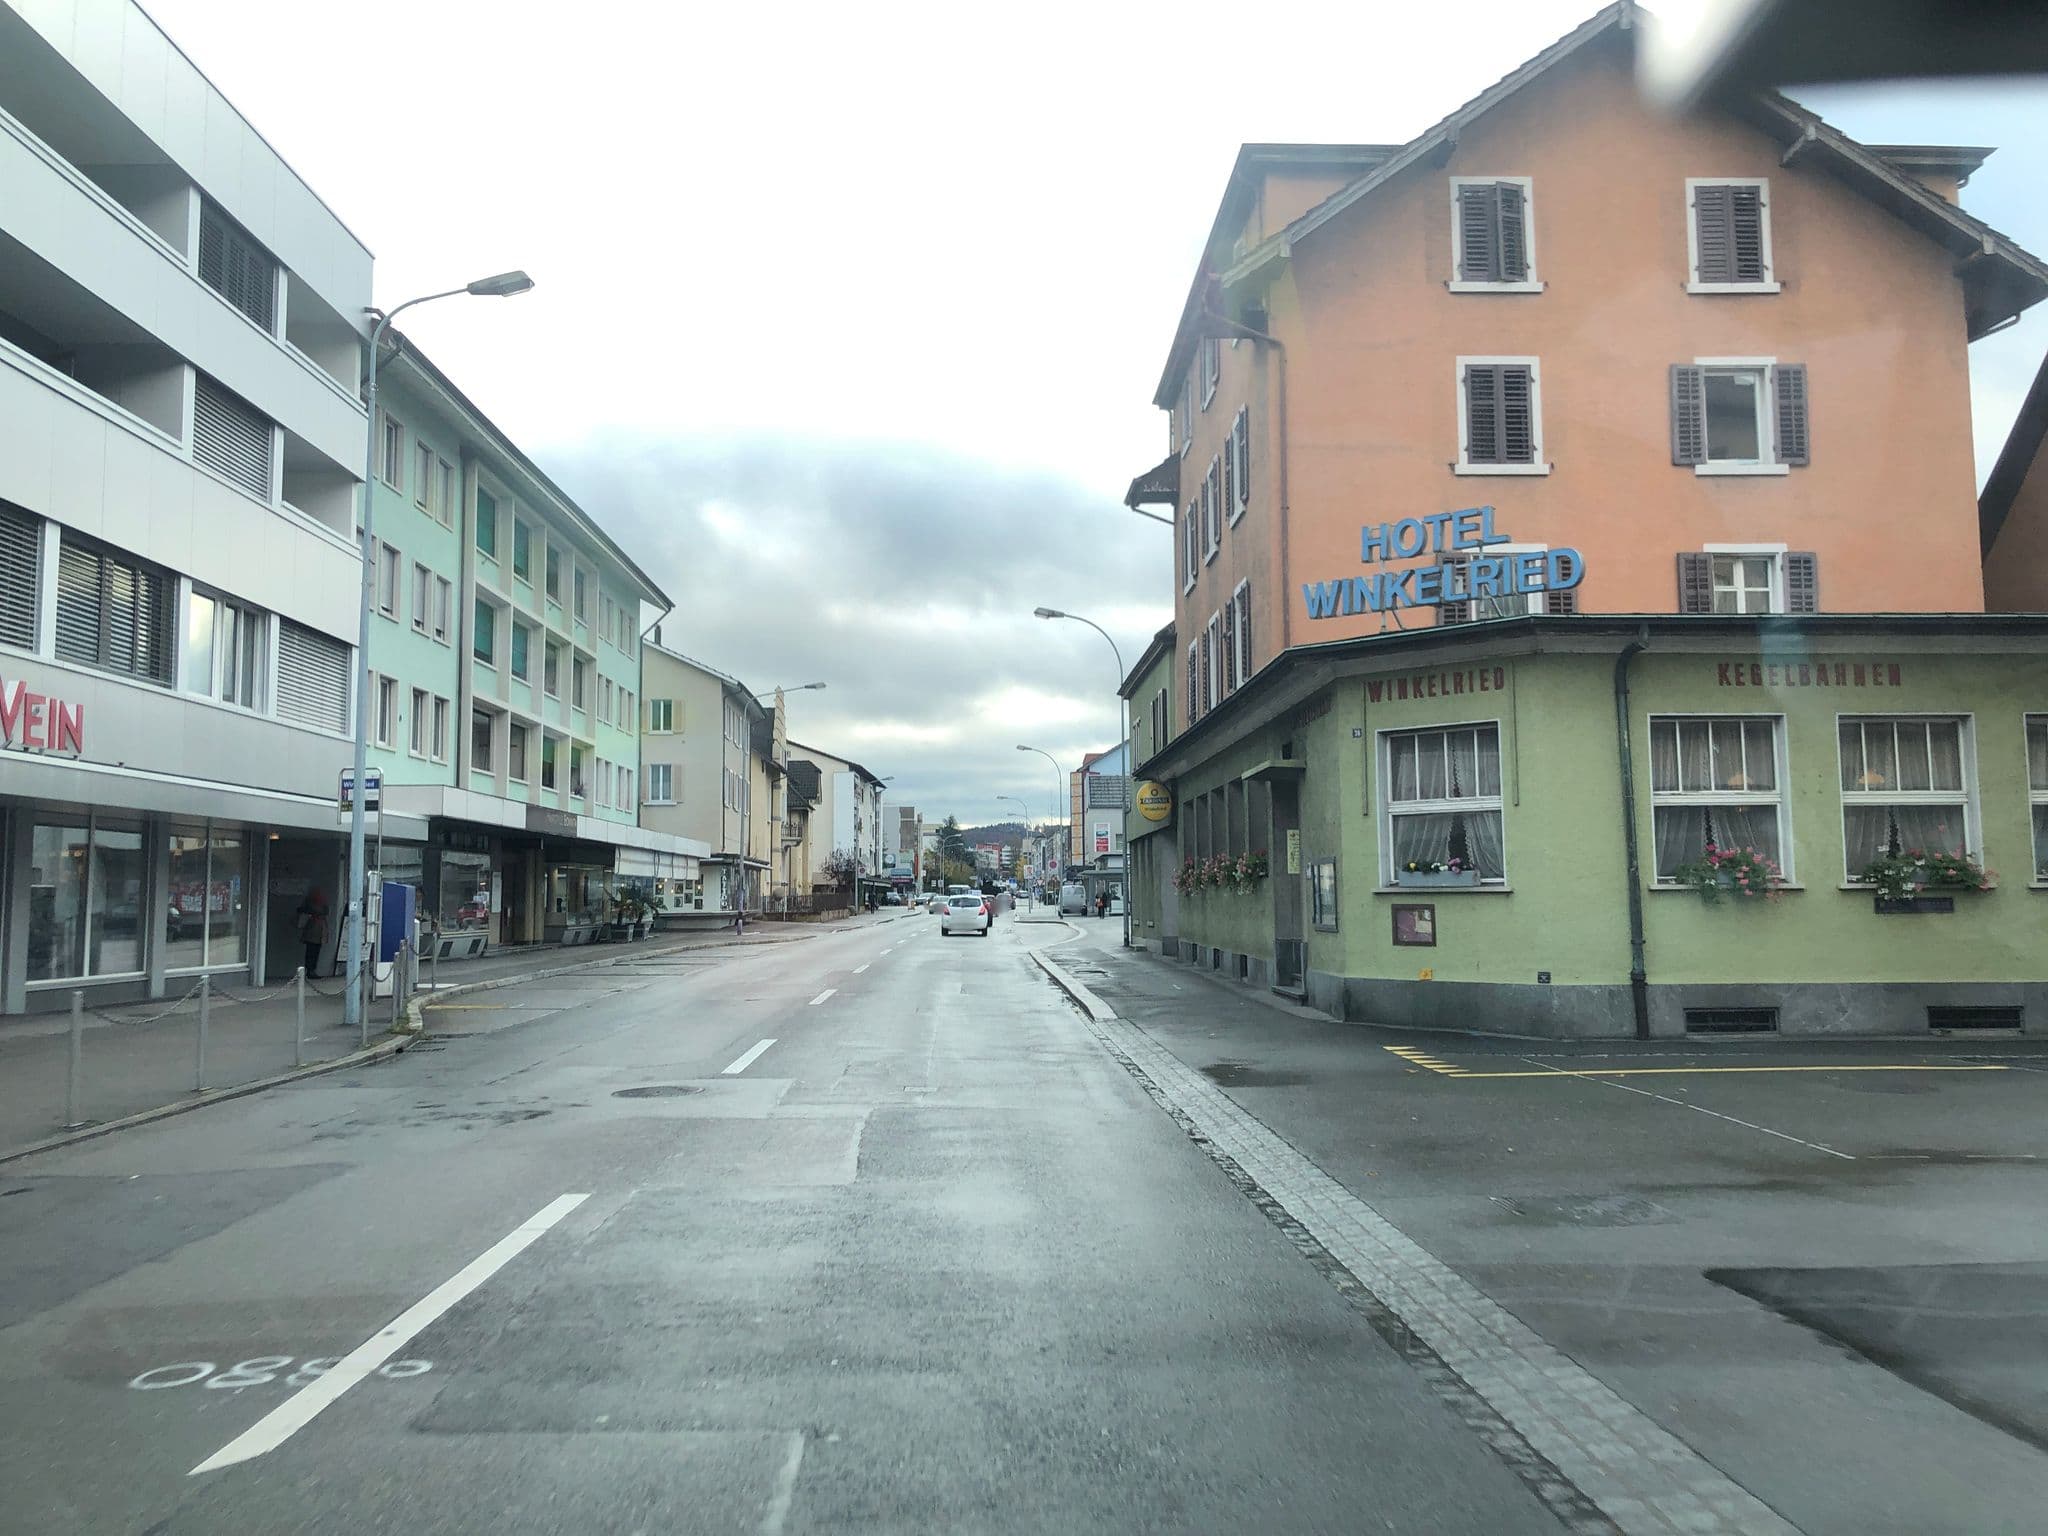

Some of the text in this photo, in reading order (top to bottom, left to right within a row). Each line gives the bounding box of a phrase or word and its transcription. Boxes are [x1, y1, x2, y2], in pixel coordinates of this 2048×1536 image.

[1361, 505, 1511, 564] HOTEL
[1302, 547, 1586, 620] WINKELRIED
[1367, 666, 1505, 703] WINKELRIED
[1717, 663, 1901, 688] KEGELBAHNEN
